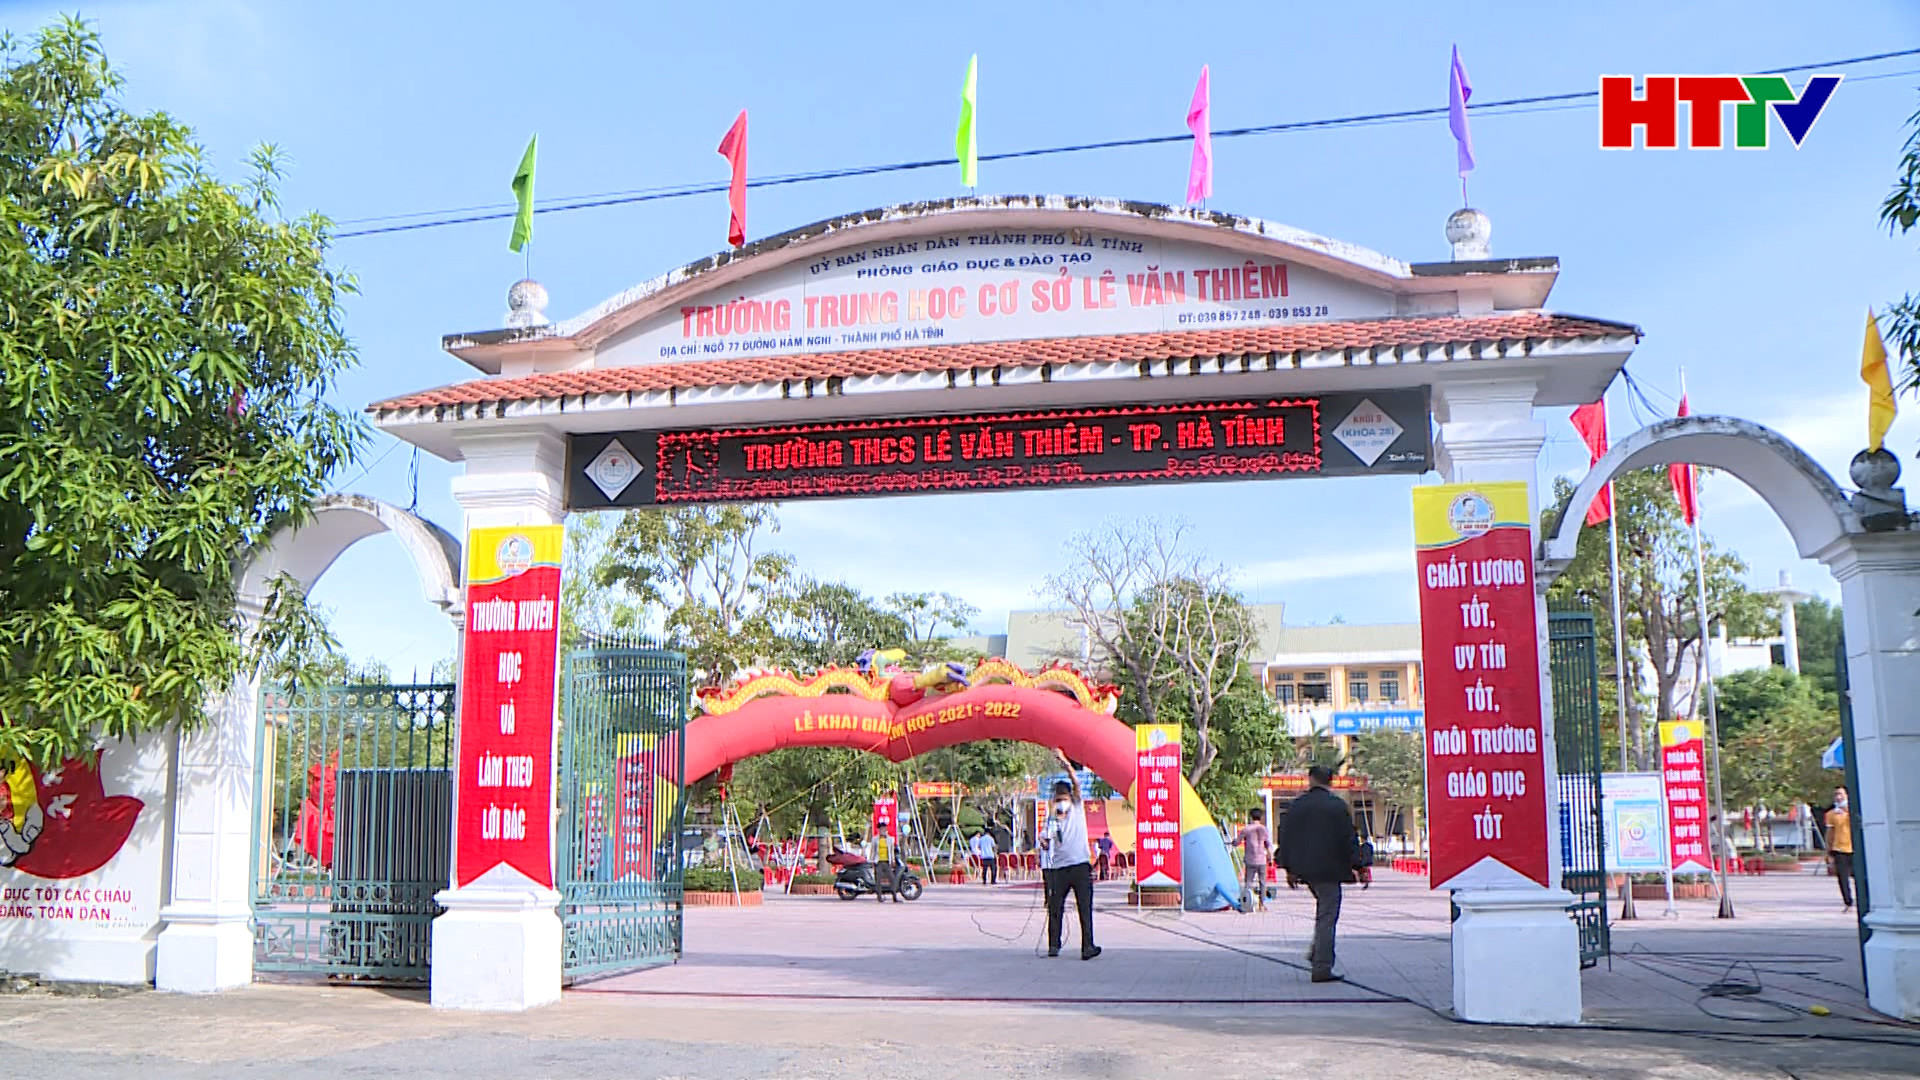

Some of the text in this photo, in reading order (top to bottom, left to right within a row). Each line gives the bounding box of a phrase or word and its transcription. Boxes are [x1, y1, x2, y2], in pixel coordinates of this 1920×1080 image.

[836, 251, 866, 267] BAN
[872, 242, 918, 259] NHÂN
[925, 236, 959, 251] DÂN
[967, 231, 1026, 245] THÀNH
[1031, 231, 1065, 246] PHỐ
[857, 264, 913, 279] PHÒNG
[921, 260, 959, 273] GIÁO
[966, 258, 1000, 271] DỤC
[1004, 258, 1015, 268] &
[1060, 252, 1092, 265] TẠO
[680, 260, 1289, 338] TRƯỜNG TRUNG HỌC CƠ SỞ LÊ VĂN THIÊM
[728, 342, 739, 351] 77
[807, 336, 831, 346] NGHI
[841, 330, 877, 343] THÀNH
[904, 328, 919, 340] HÀ
[743, 437, 842, 471] TRƯỜNG
[849, 436, 916, 465] THCS
[923, 429, 952, 461] LÊ
[960, 426, 1014, 459] VĂN
[1020, 422, 1103, 457] THIÊM
[1128, 423, 1169, 451] TP.
[1177, 415, 1214, 449] HÀ
[1221, 414, 1284, 447] TĨNH
[1426, 553, 1525, 590] CHẤT LƯỢNG
[472, 595, 554, 632] THƯỜNG XUYÊN
[498, 652, 522, 688] HỌC
[1455, 639, 1506, 670] UY TÍN
[500, 698, 516, 735] VÀ
[818, 714, 858, 730] KHAI
[906, 712, 935, 733] HỌC
[938, 703, 973, 723] 2021
[984, 701, 1021, 718] 2022
[1433, 723, 1537, 755] MÔI TRƯỜNG
[478, 750, 533, 787] LÀM THEO
[1447, 766, 1526, 801] GIÁO DỤC
[482, 802, 526, 840] LỜI BÁC
[1473, 804, 1503, 839] TỐT
[39, 903, 74, 919] TOÀN
[94, 885, 132, 903] CHÁU
